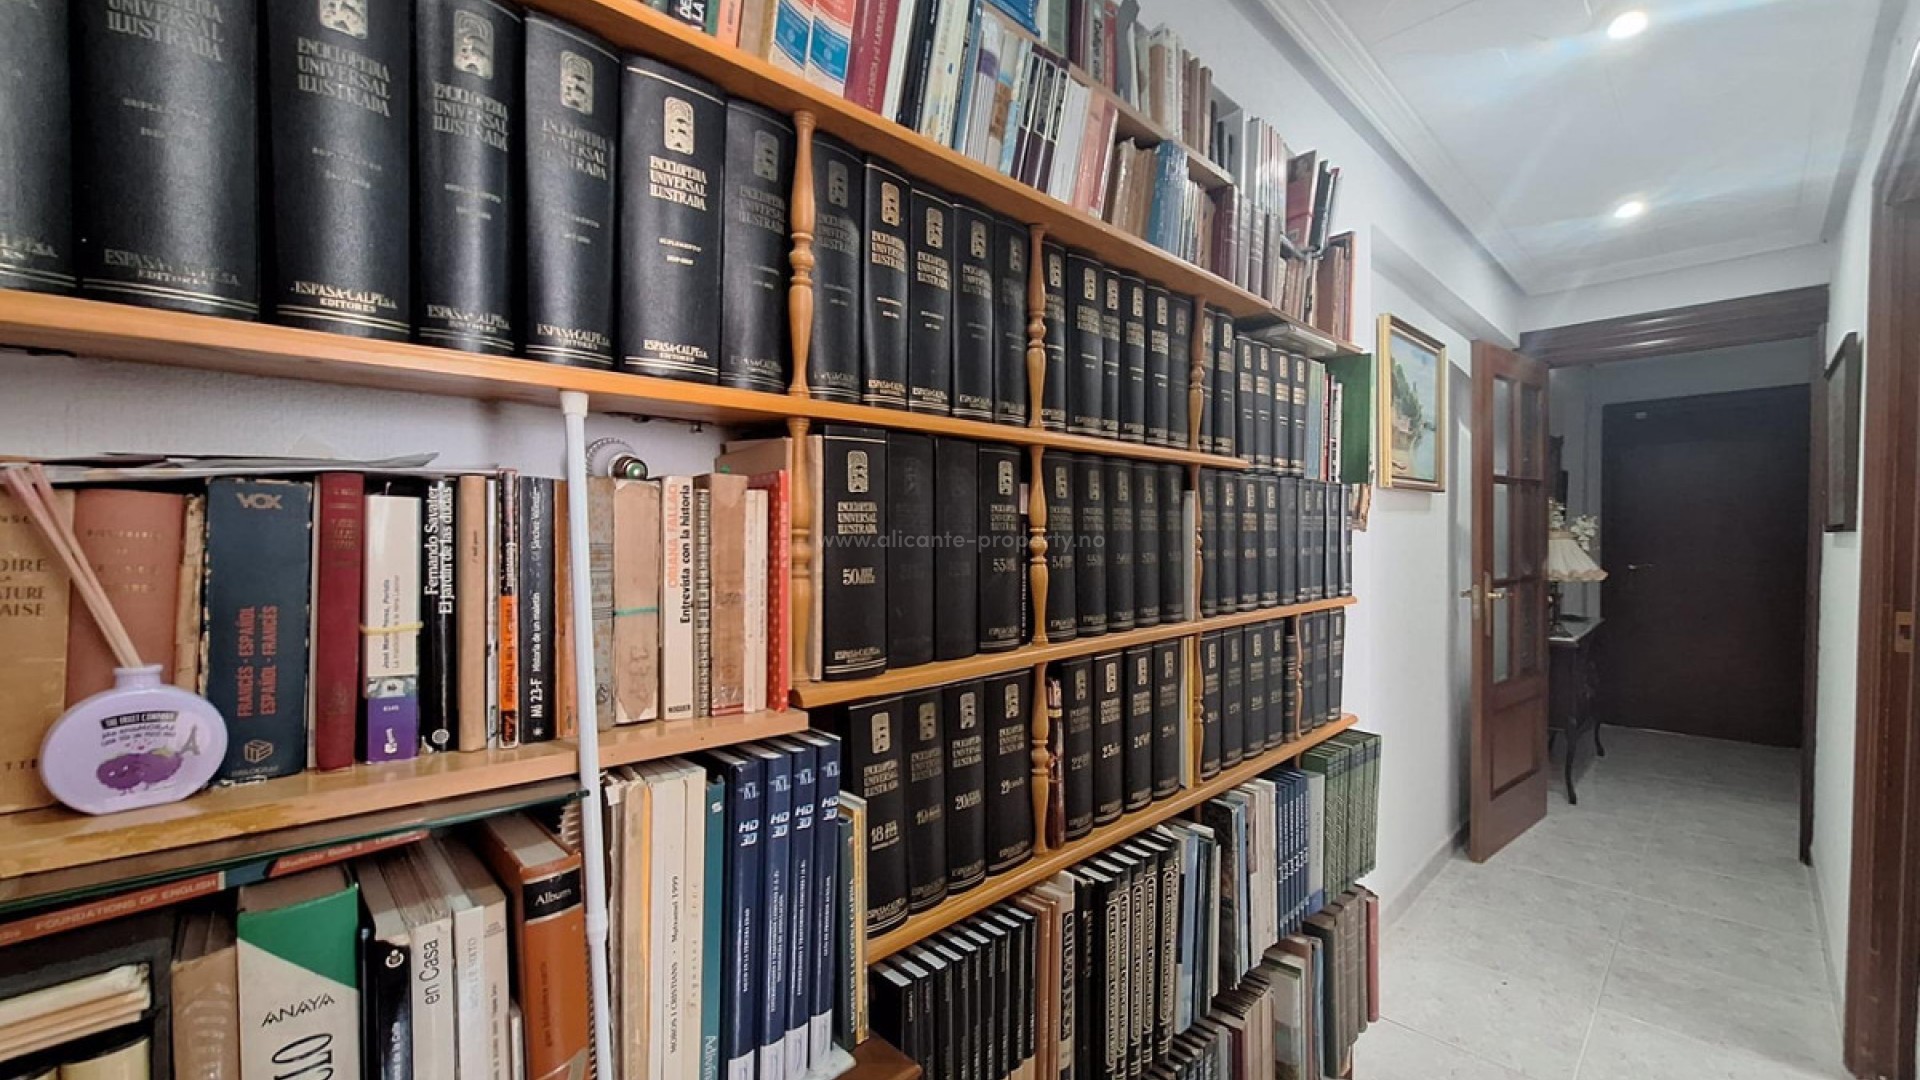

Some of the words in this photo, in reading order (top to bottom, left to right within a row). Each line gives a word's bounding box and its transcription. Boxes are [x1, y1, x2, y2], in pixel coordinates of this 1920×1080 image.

[297, 54, 391, 99] UNIVERSAL
[298, 73, 391, 117] ILUSTRADA
[650, 168, 708, 197] UNIVERSAL
[650, 183, 708, 212] ILUSTRADA
[319, 298, 377, 313] EDITORES
[236, 492, 283, 509] VOX
[424, 485, 439, 533] Savater
[438, 486, 453, 523] dudas
[679, 484, 691, 527] historia
[438, 525, 453, 544] las
[680, 529, 691, 541] la
[438, 545, 453, 562] de
[667, 537, 678, 589] ORIANA
[680, 543, 691, 572] con
[424, 535, 439, 596] Fernando
[843, 568, 860, 585] 50
[438, 601, 453, 615] El
[679, 578, 692, 624] Entrevista
[236, 606, 256, 657] ESPAÑOL
[259, 605, 278, 656] FRANCÉS
[532, 621, 541, 632] un
[532, 632, 541, 643] de
[532, 644, 541, 672] Historia
[235, 666, 255, 717] FRANCÉS
[258, 665, 277, 715] ESPAÑOL
[530, 678, 542, 702] 23-F
[530, 704, 542, 718] Mi
[794, 803, 814, 817] HD
[822, 795, 839, 808] HD
[770, 811, 790, 825] HD
[796, 816, 812, 830] 3D
[823, 808, 838, 821] 3D
[738, 819, 759, 834] HD
[771, 824, 788, 839] 3D
[871, 824, 884, 843] 18
[740, 832, 758, 847] 3D
[36, 900, 137, 931] FOUNDATIONS
[140, 893, 155, 905] OF
[161, 879, 217, 899] ENGLISH
[535, 888, 572, 907] Album
[419, 939, 441, 982] Casa
[424, 983, 441, 1005] en
[261, 993, 335, 1028] ANAYA
